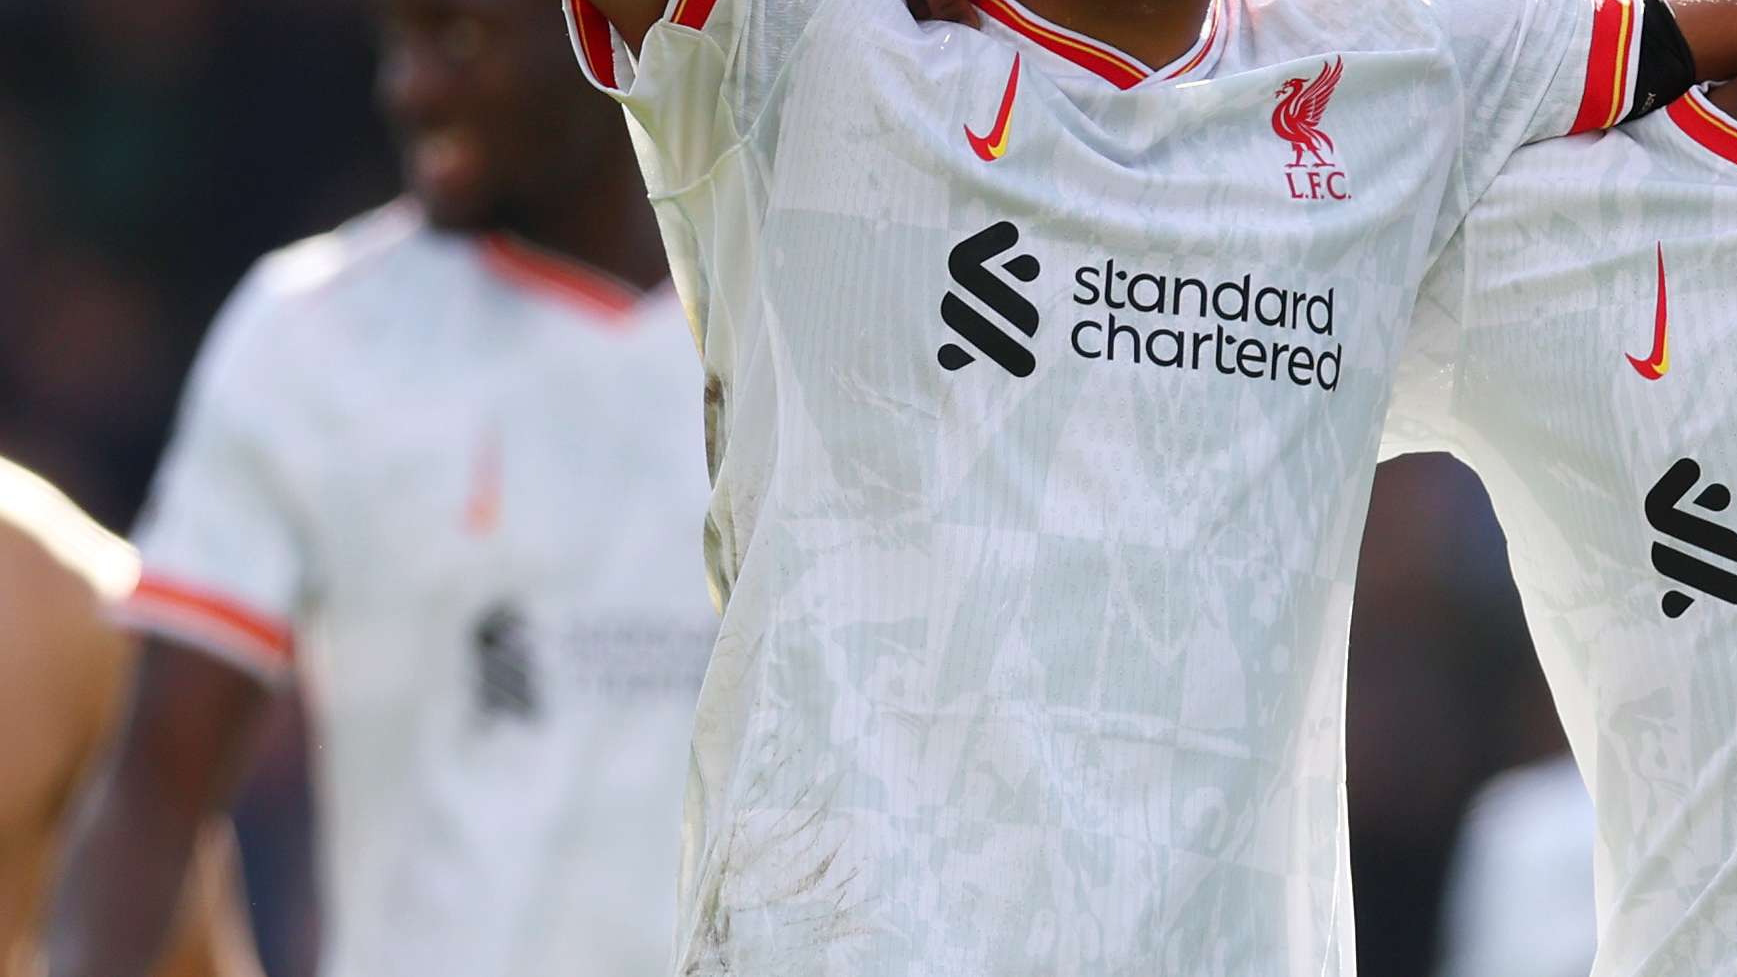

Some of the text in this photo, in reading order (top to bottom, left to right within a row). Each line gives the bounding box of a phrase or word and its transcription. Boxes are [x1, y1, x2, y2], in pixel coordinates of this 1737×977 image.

[1285, 171, 1352, 200] L.F.C.
[1073, 258, 1334, 336] standard
[1070, 312, 1342, 392] chartered
